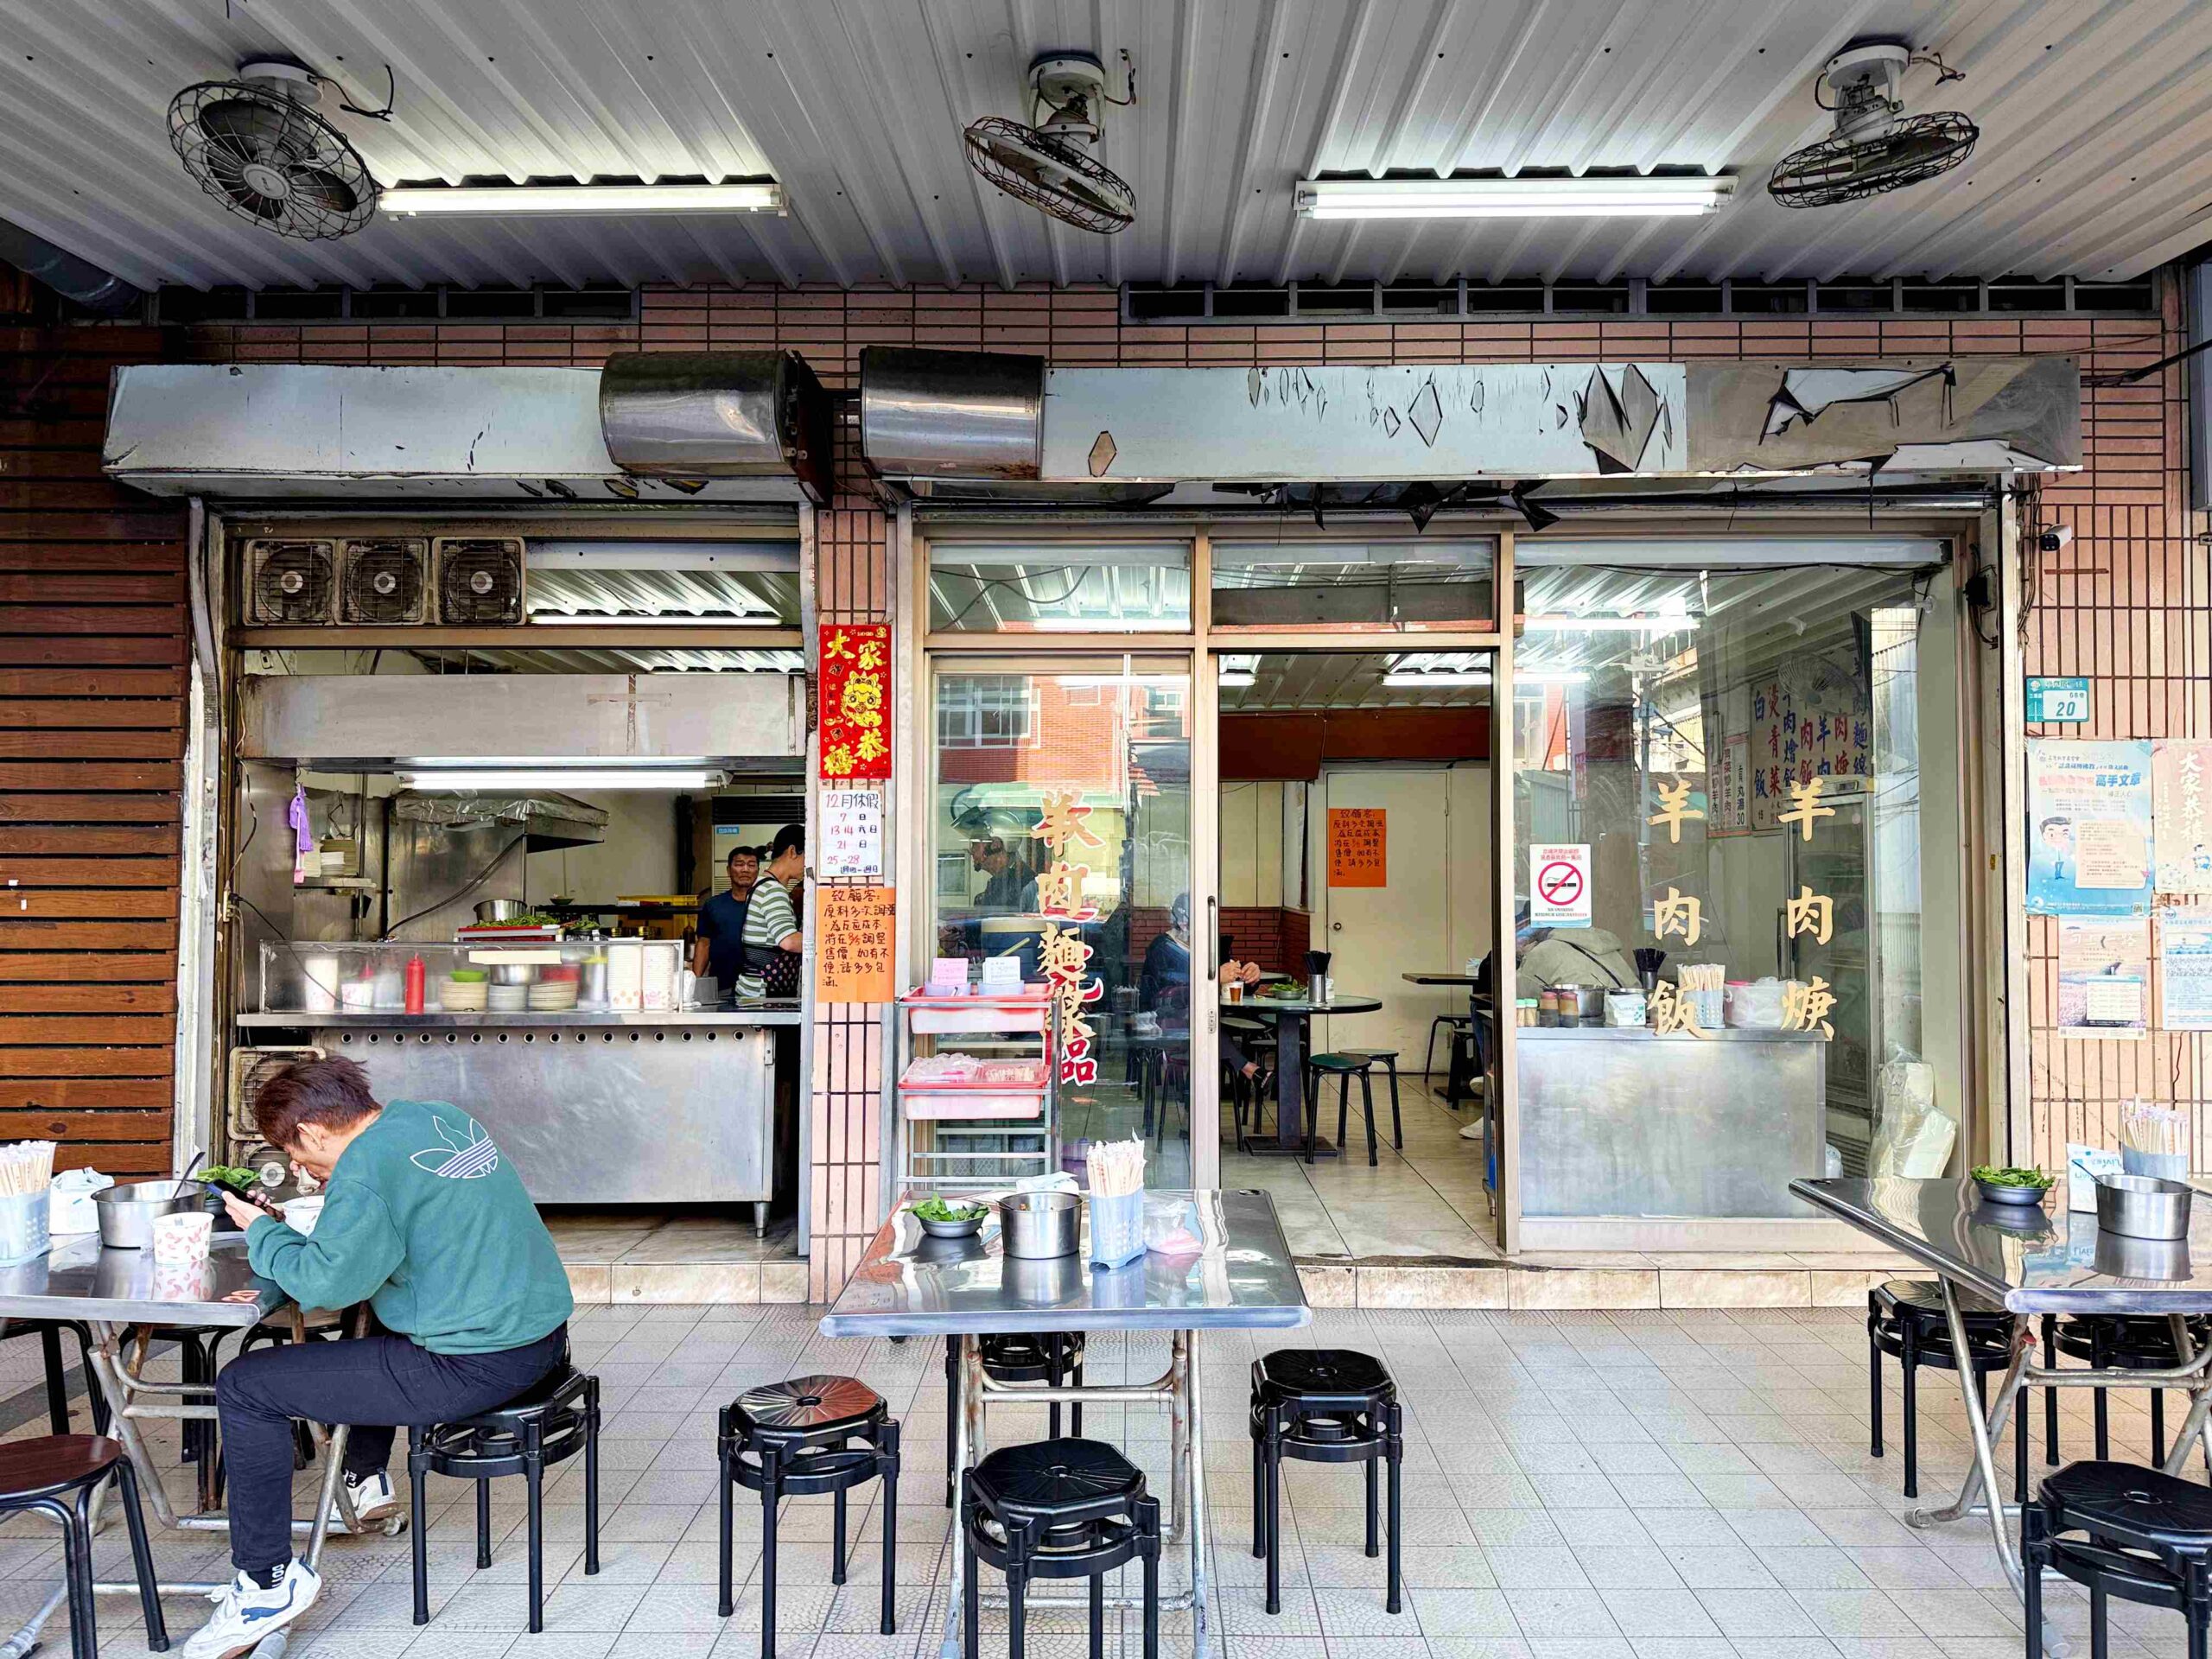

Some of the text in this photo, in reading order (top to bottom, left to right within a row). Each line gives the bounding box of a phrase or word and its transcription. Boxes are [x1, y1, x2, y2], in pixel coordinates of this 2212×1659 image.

[2056, 701, 2075, 717] 20
[1768, 683, 1783, 798] 燙青菜
[826, 793, 879, 810] 12月休假
[840, 813, 847, 822] 7
[830, 825, 840, 835] 13
[844, 825, 853, 836] 14
[836, 840, 846, 849] 21
[1645, 778, 1712, 1041] 羊肉飯
